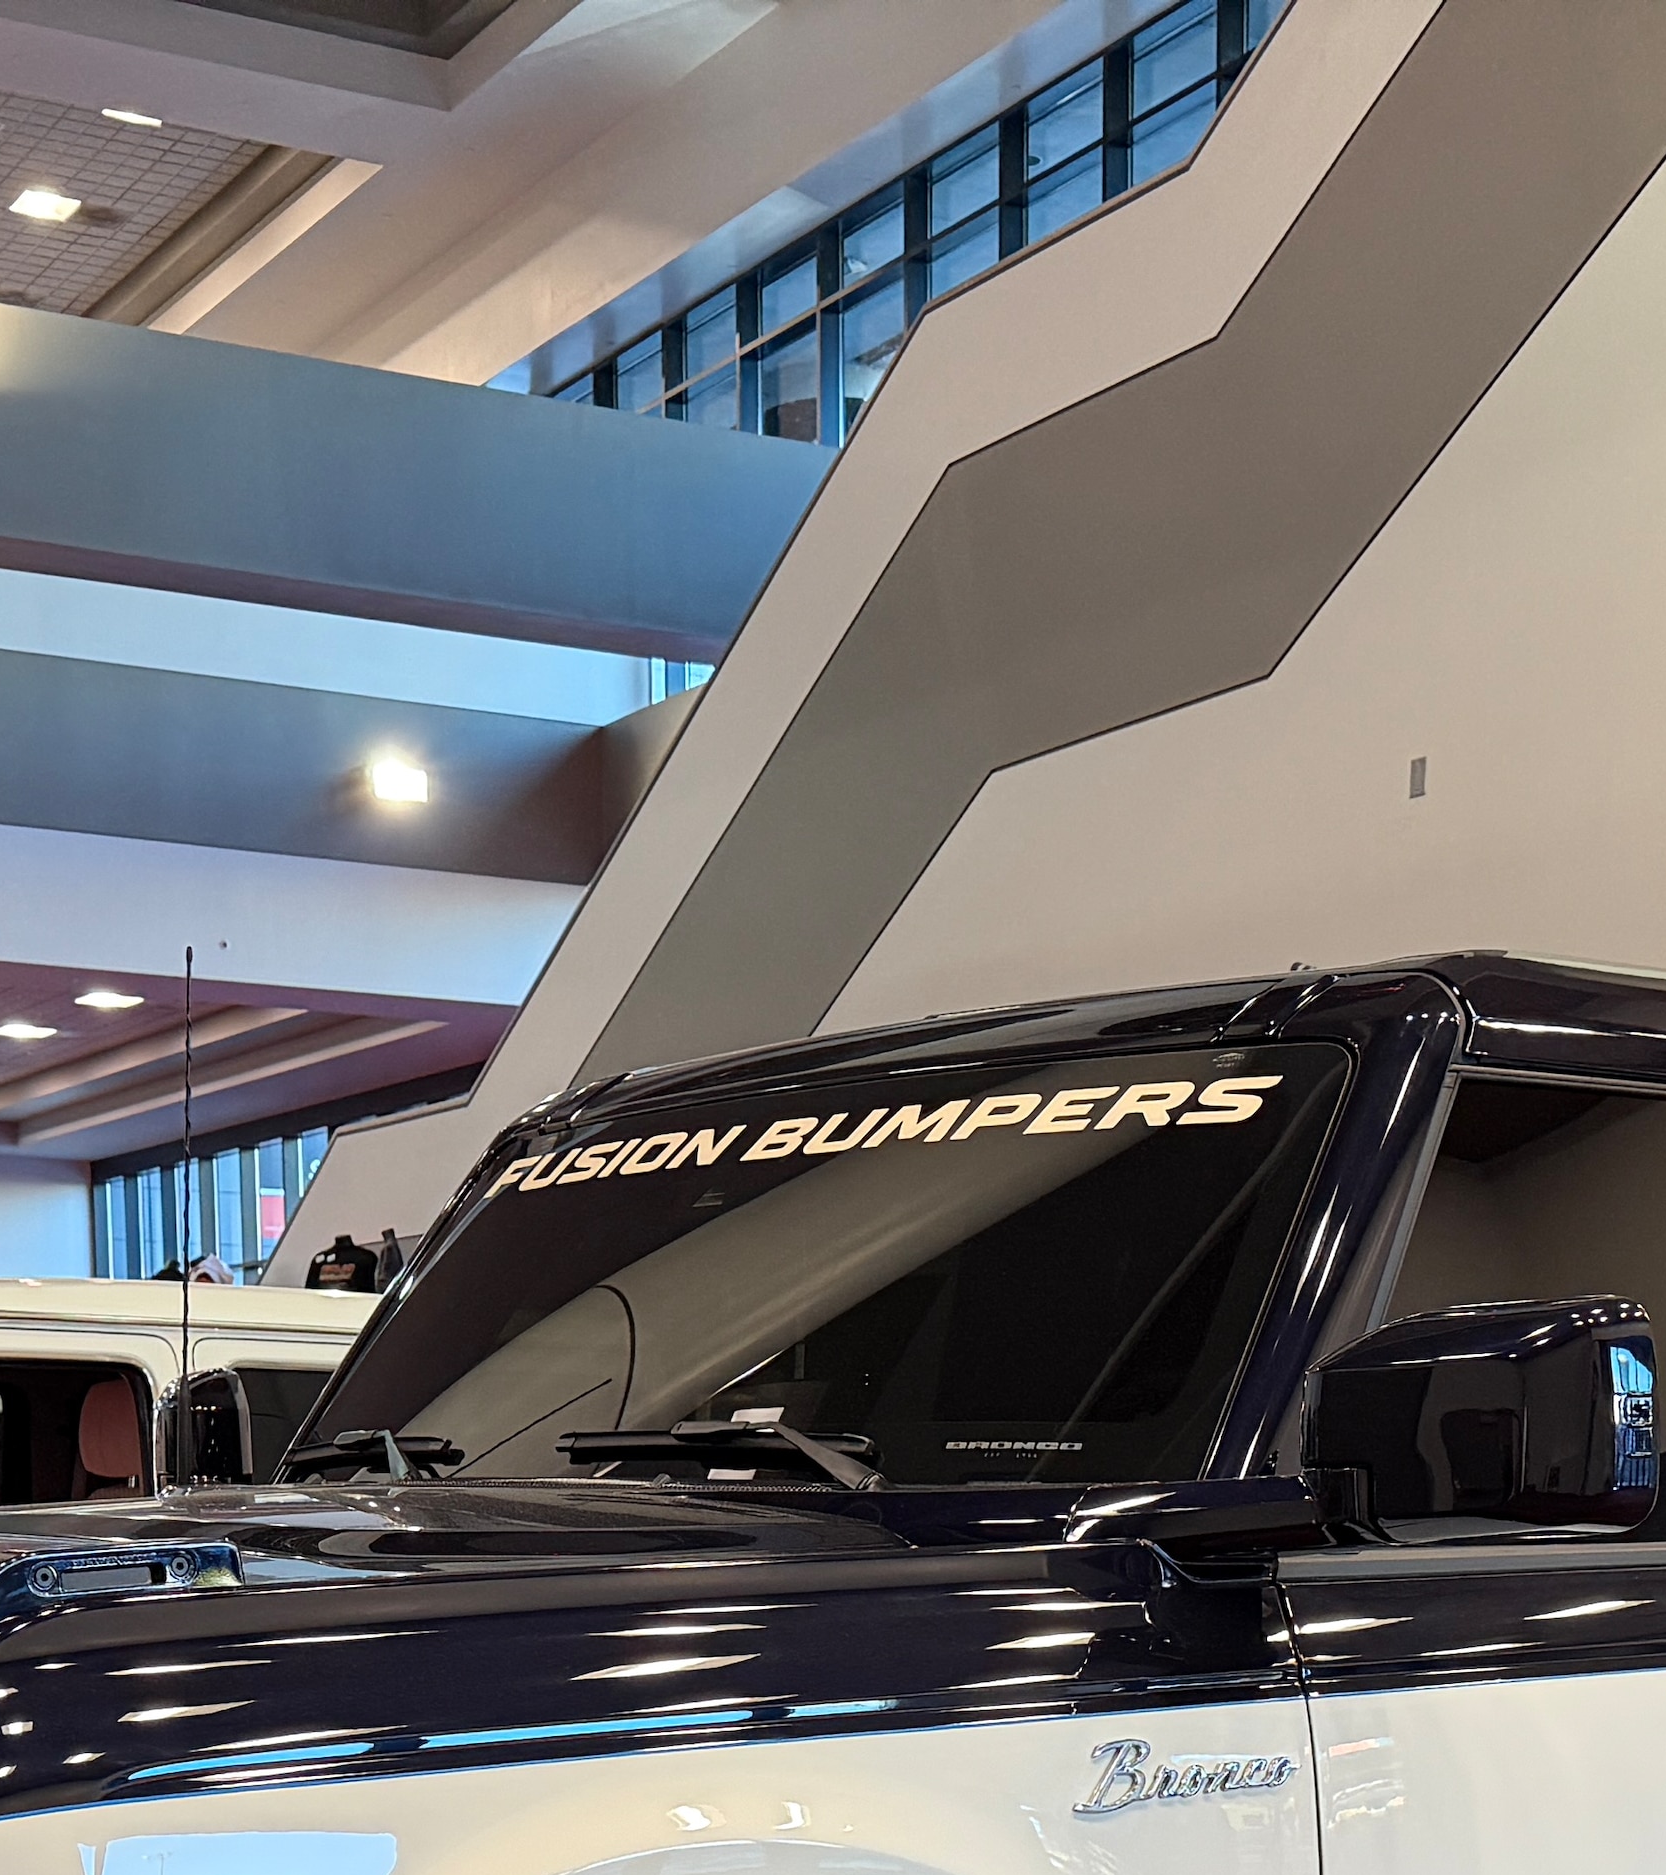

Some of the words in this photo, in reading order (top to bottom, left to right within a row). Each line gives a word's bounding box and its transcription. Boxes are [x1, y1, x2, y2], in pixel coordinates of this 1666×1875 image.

[482, 1124, 747, 1200] FUSION
[740, 1075, 1284, 1162] BUMPERS
[1072, 1738, 1301, 1814] Bronco
